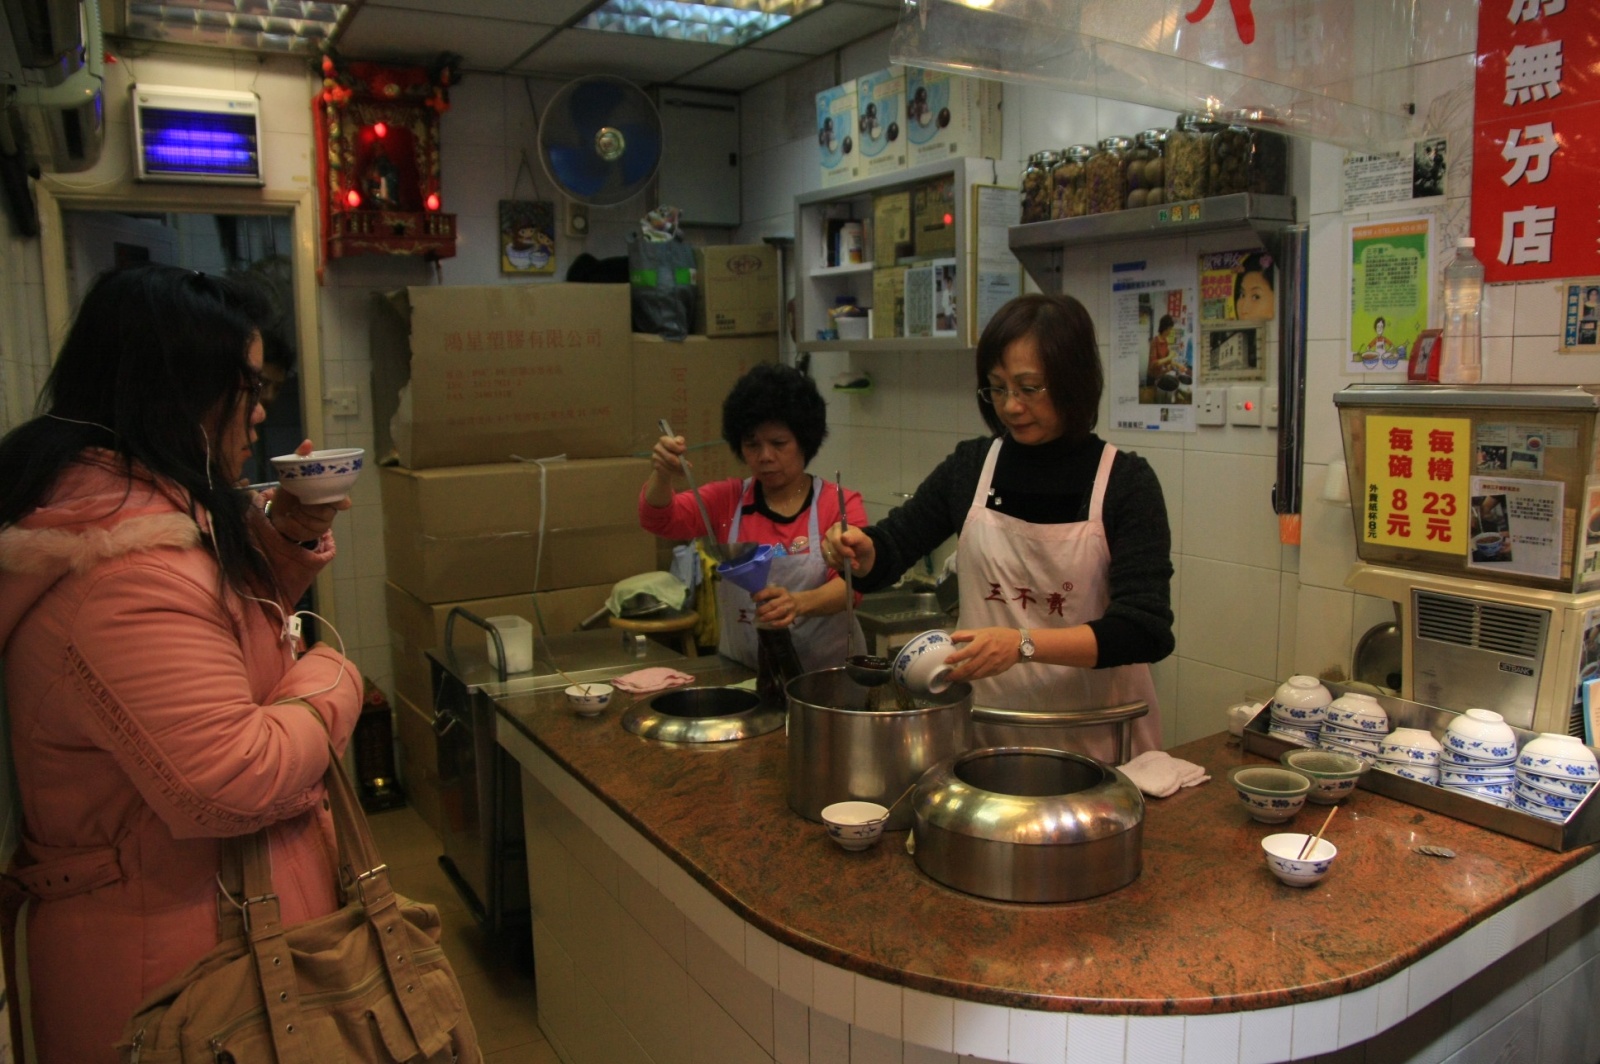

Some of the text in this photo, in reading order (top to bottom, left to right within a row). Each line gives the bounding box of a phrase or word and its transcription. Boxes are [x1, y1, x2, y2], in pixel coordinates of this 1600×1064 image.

[1386, 426, 1413, 538] 每碗8元
[1422, 429, 1457, 543] 每樽23元
